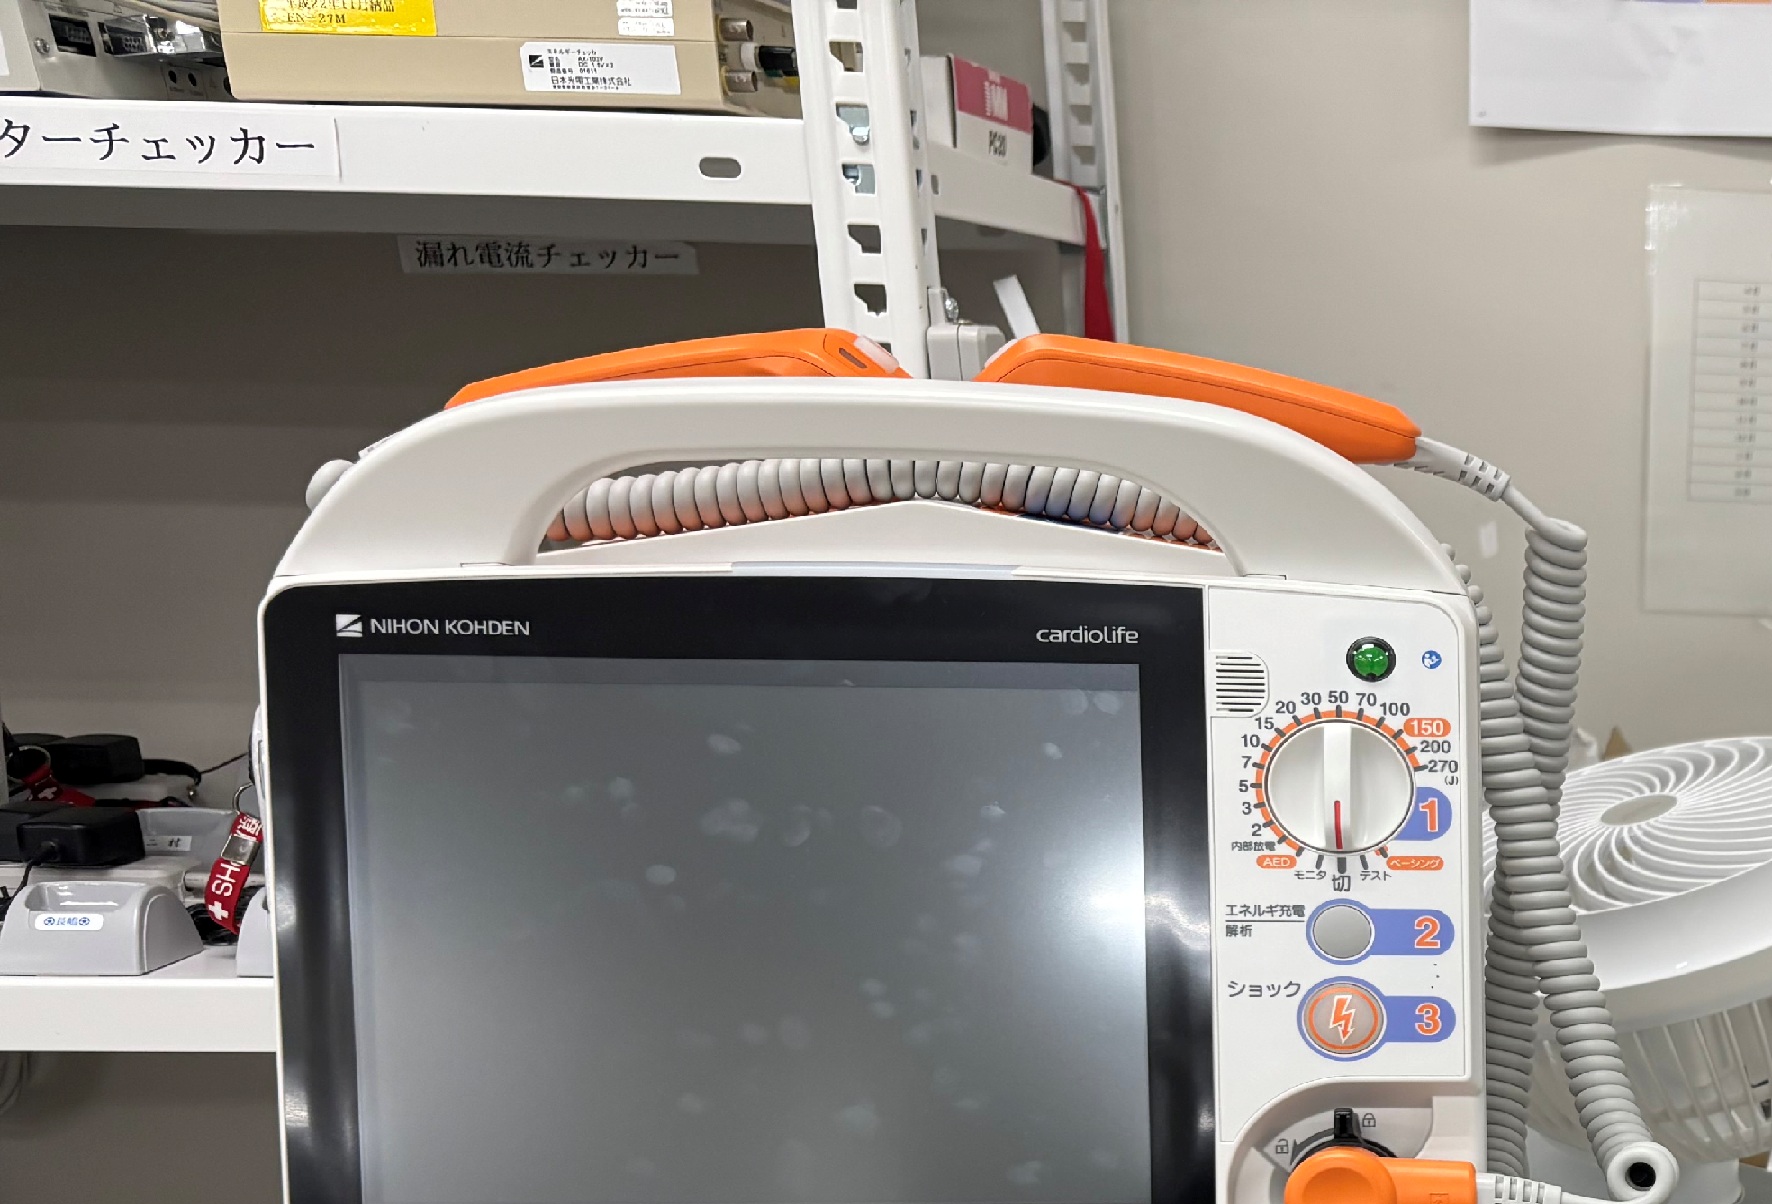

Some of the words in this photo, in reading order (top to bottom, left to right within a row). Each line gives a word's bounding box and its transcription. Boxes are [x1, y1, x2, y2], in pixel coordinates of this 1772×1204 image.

[0, 118, 316, 165] ターチェッカー
[415, 239, 680, 269] 漏れ電流チェッカー
[370, 618, 439, 635] NIHON
[446, 619, 530, 636] KOHDEN
[1036, 625, 1139, 644] cardiolife
[1300, 692, 1322, 705] 30
[1328, 690, 1349, 704] 50
[1356, 693, 1377, 706] 70
[1275, 701, 1297, 714] 20
[1380, 702, 1411, 716] 100
[1255, 717, 1275, 730] 15
[1411, 720, 1445, 736] 150
[1241, 735, 1261, 748] 10
[1420, 740, 1452, 753] 200
[1241, 756, 1252, 769] 7
[1428, 760, 1459, 773] 270
[1238, 779, 1249, 792] 5
[1242, 802, 1252, 815] 3
[1418, 798, 1439, 833] 1
[1251, 823, 1263, 837] 2
[1262, 856, 1291, 868] AED
[1389, 858, 1441, 869] ペーシング
[1294, 870, 1327, 881] モニタ
[1360, 870, 1392, 881] テスト
[1332, 875, 1351, 892] 切
[1225, 904, 1306, 918] エネルギ充電
[1225, 924, 1253, 938] 解析
[1414, 916, 1441, 949] 2
[1227, 980, 1301, 998] ショック
[1415, 1003, 1442, 1036] 3
